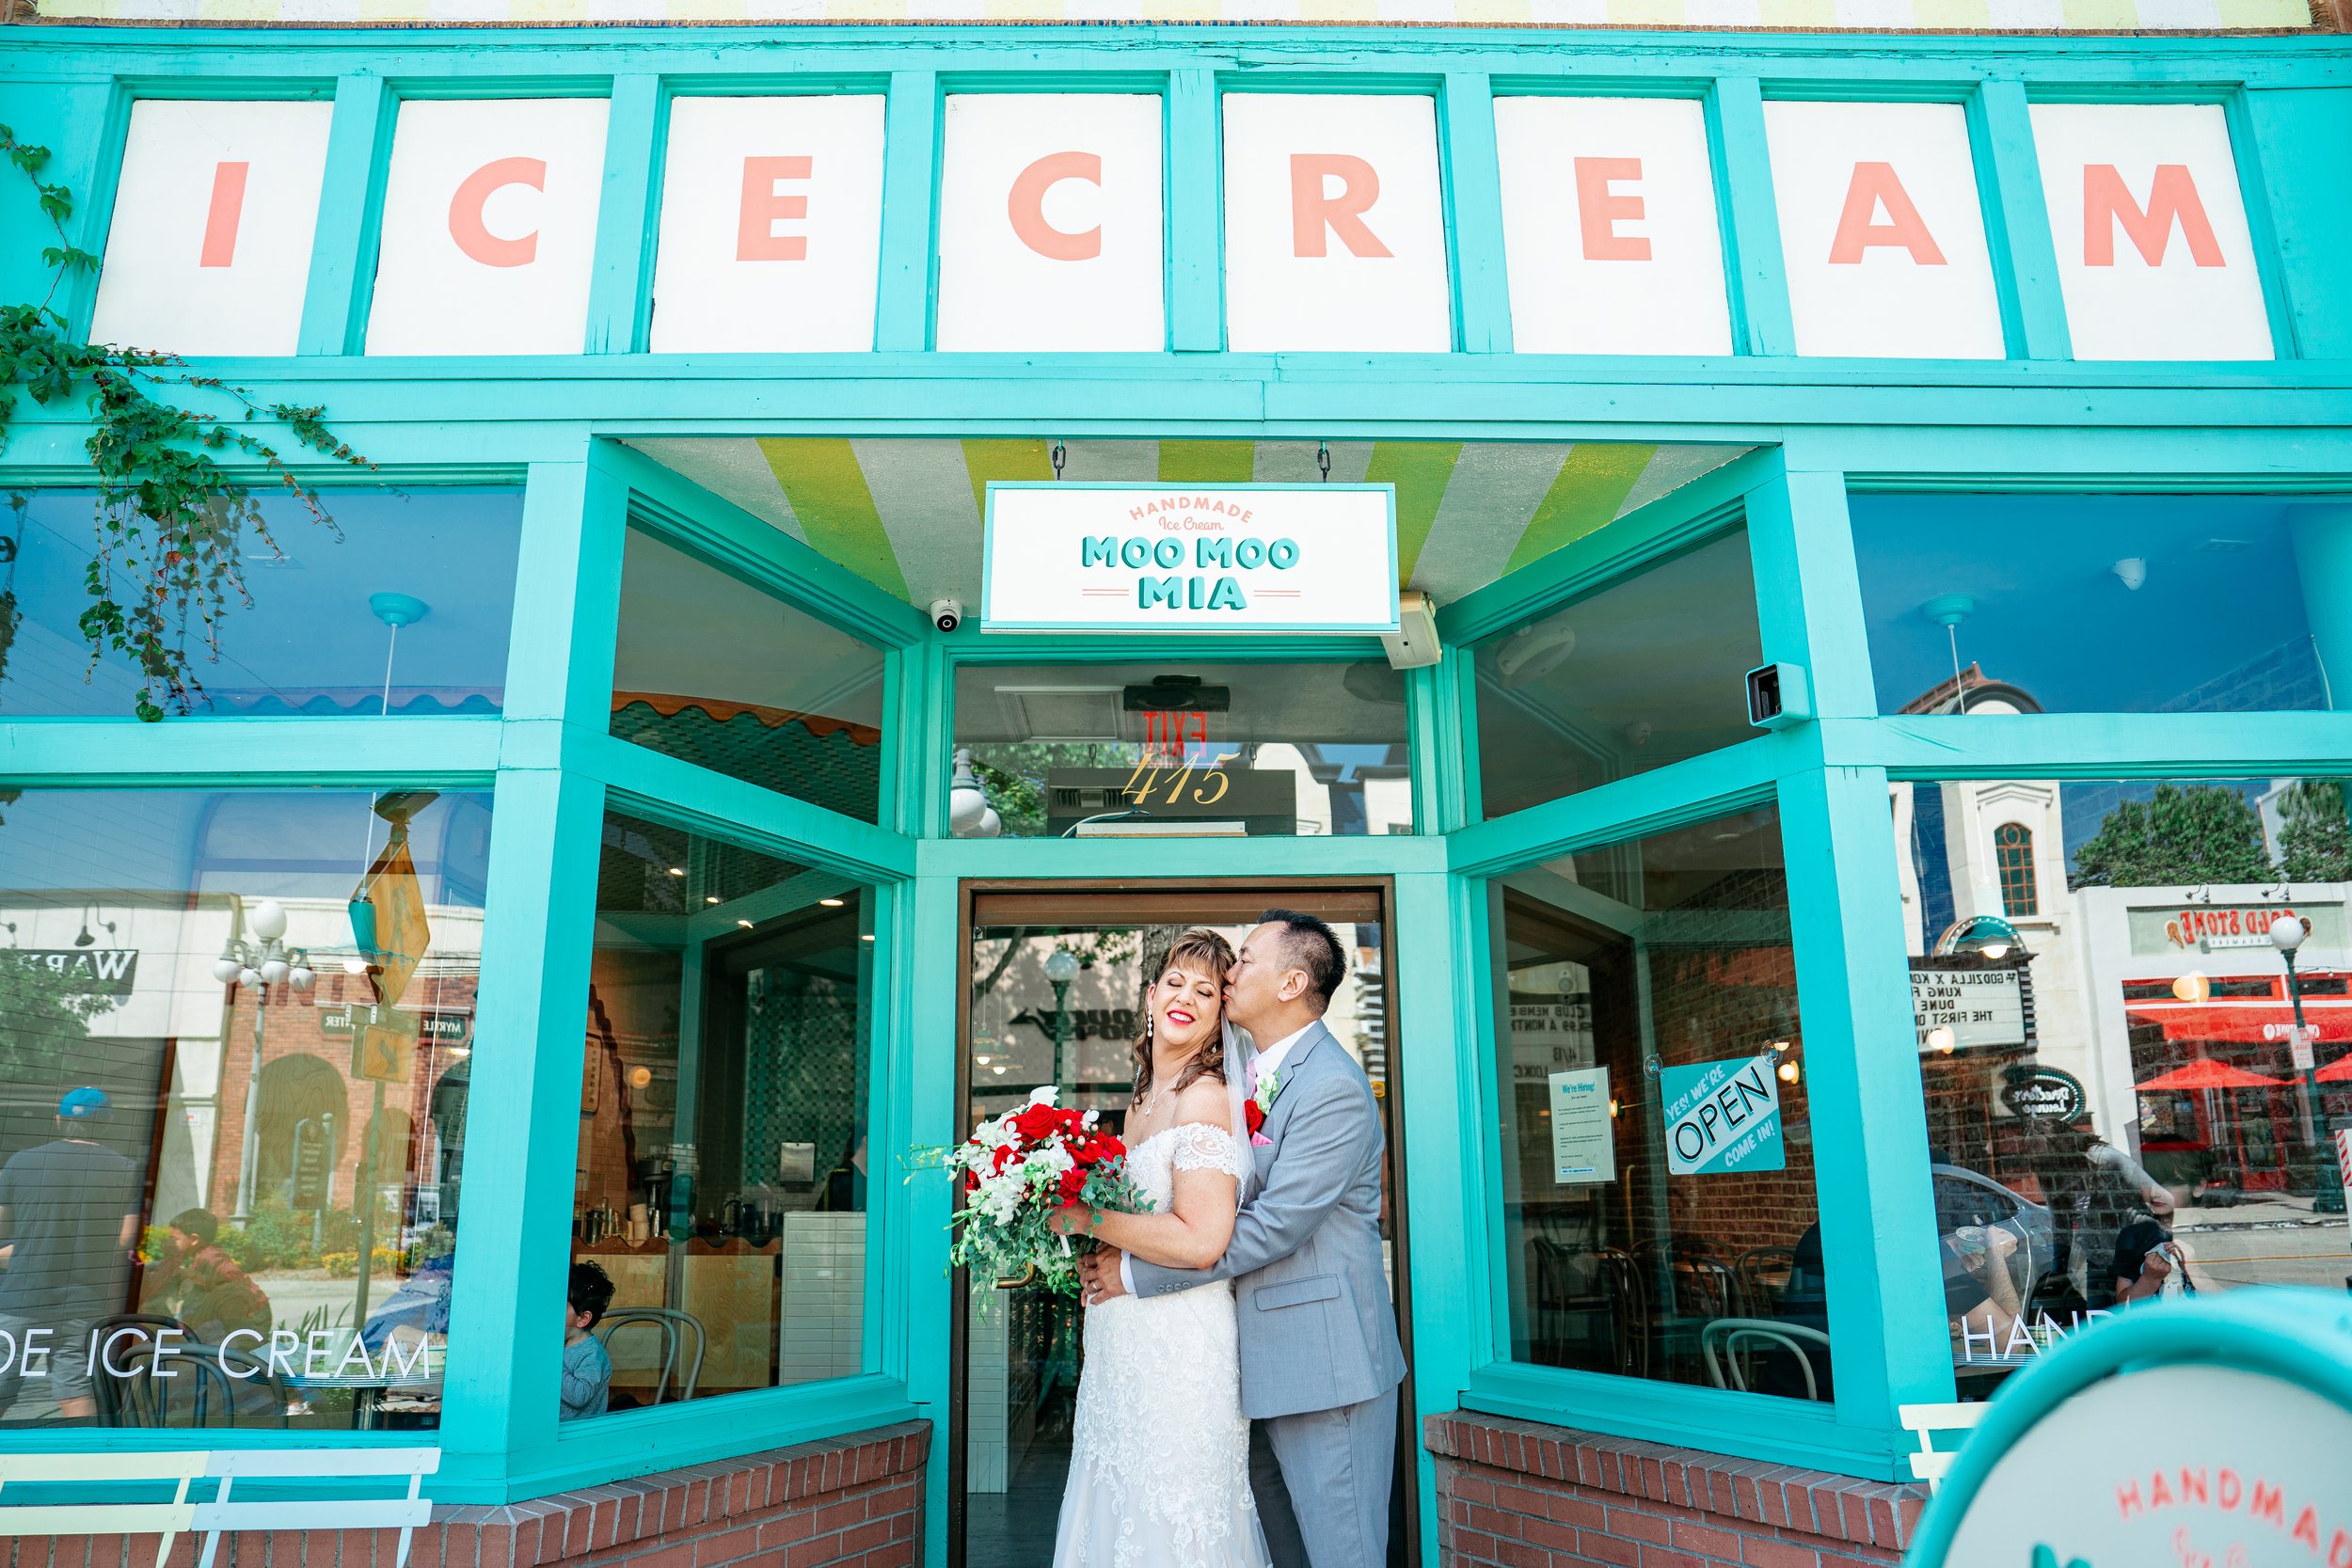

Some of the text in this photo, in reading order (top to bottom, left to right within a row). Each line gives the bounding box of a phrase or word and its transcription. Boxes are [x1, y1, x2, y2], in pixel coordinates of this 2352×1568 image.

[1130, 497, 1253, 523] HANDMADE
[1158, 515, 1224, 531] Ice Cream
[1082, 535, 1300, 570] MOO MOO
[1138, 576, 1248, 610] MIA
[1121, 752, 1240, 804] 415
[1666, 1064, 1725, 1121] YES! WE'RE
[1674, 1066, 1771, 1164] OPEN
[1724, 1118, 1775, 1167] COME IN!
[87, 1328, 183, 1378] ICE
[218, 1328, 430, 1380] CREAM
